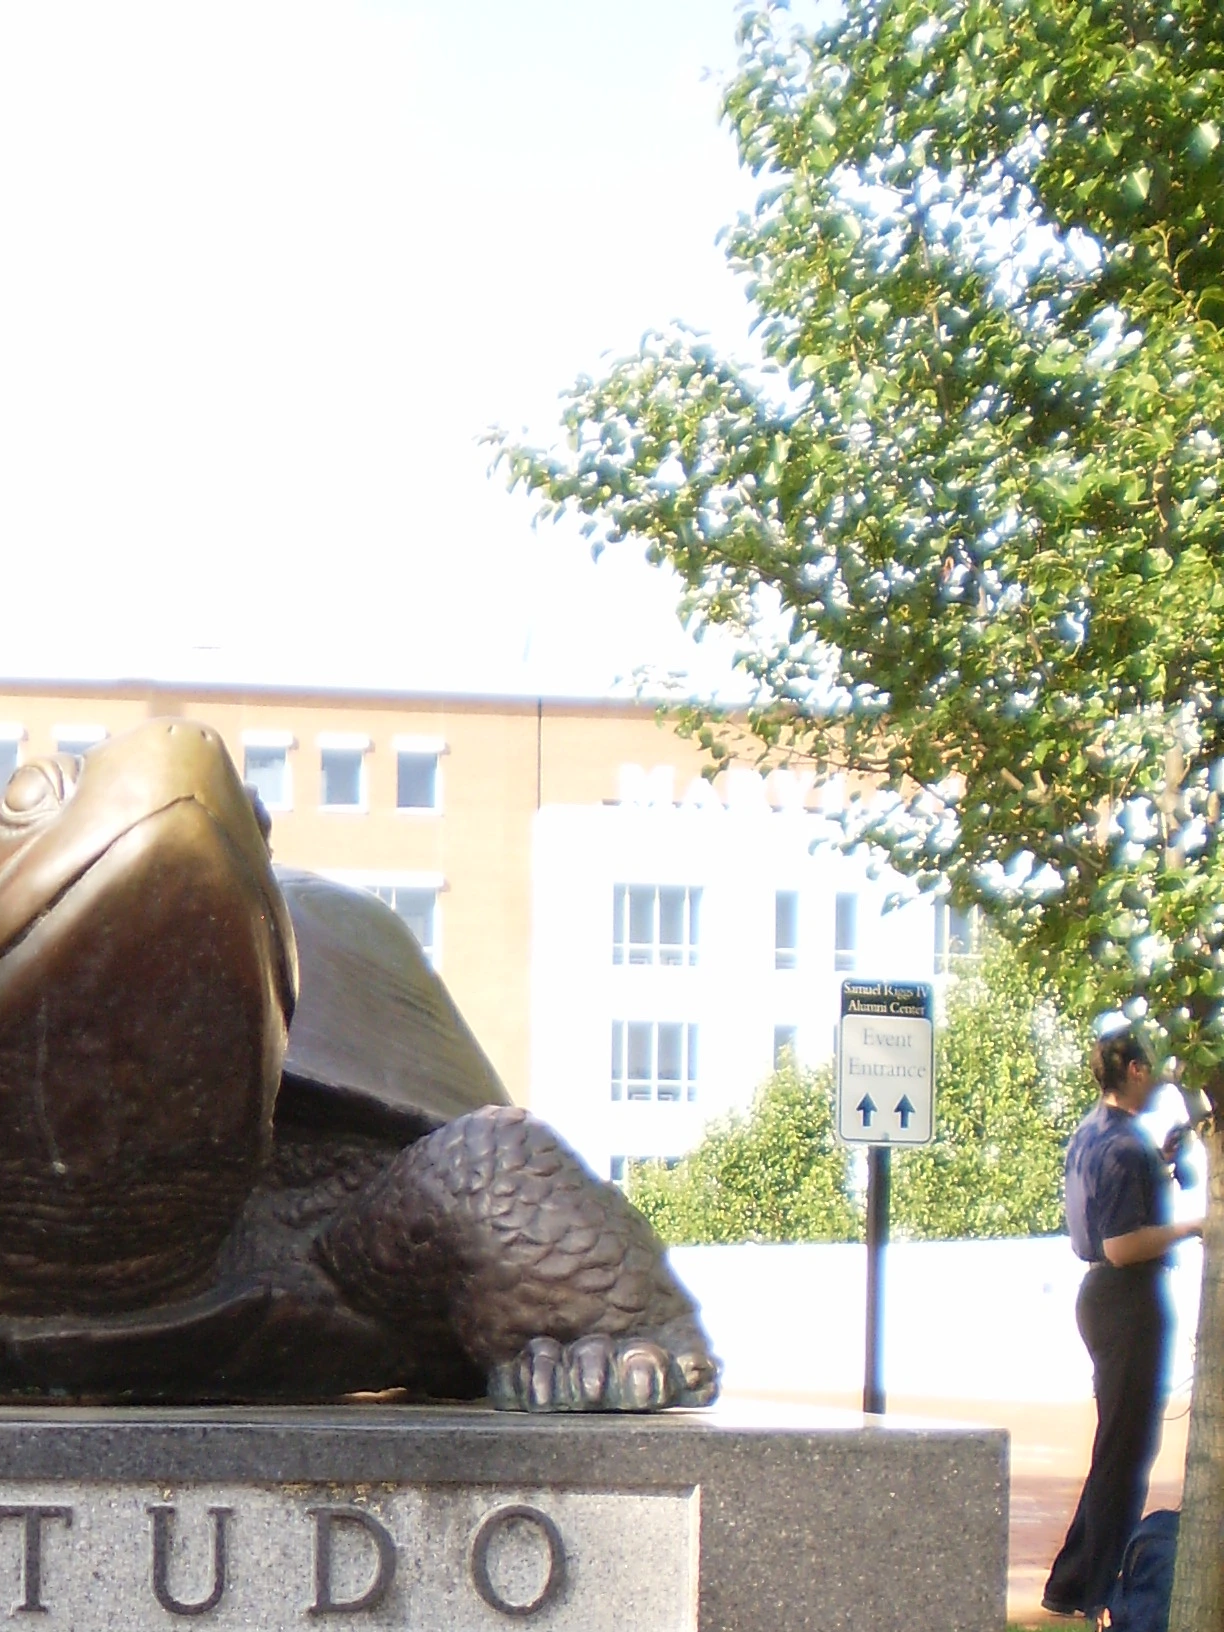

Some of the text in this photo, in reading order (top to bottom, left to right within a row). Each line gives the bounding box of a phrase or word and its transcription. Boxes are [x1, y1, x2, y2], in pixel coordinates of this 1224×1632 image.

[844, 982, 928, 1000] Samuel Riggs IV
[848, 1000, 925, 1015] Alumni Center
[862, 1028, 913, 1048] Event
[848, 1057, 927, 1079] Entrance
